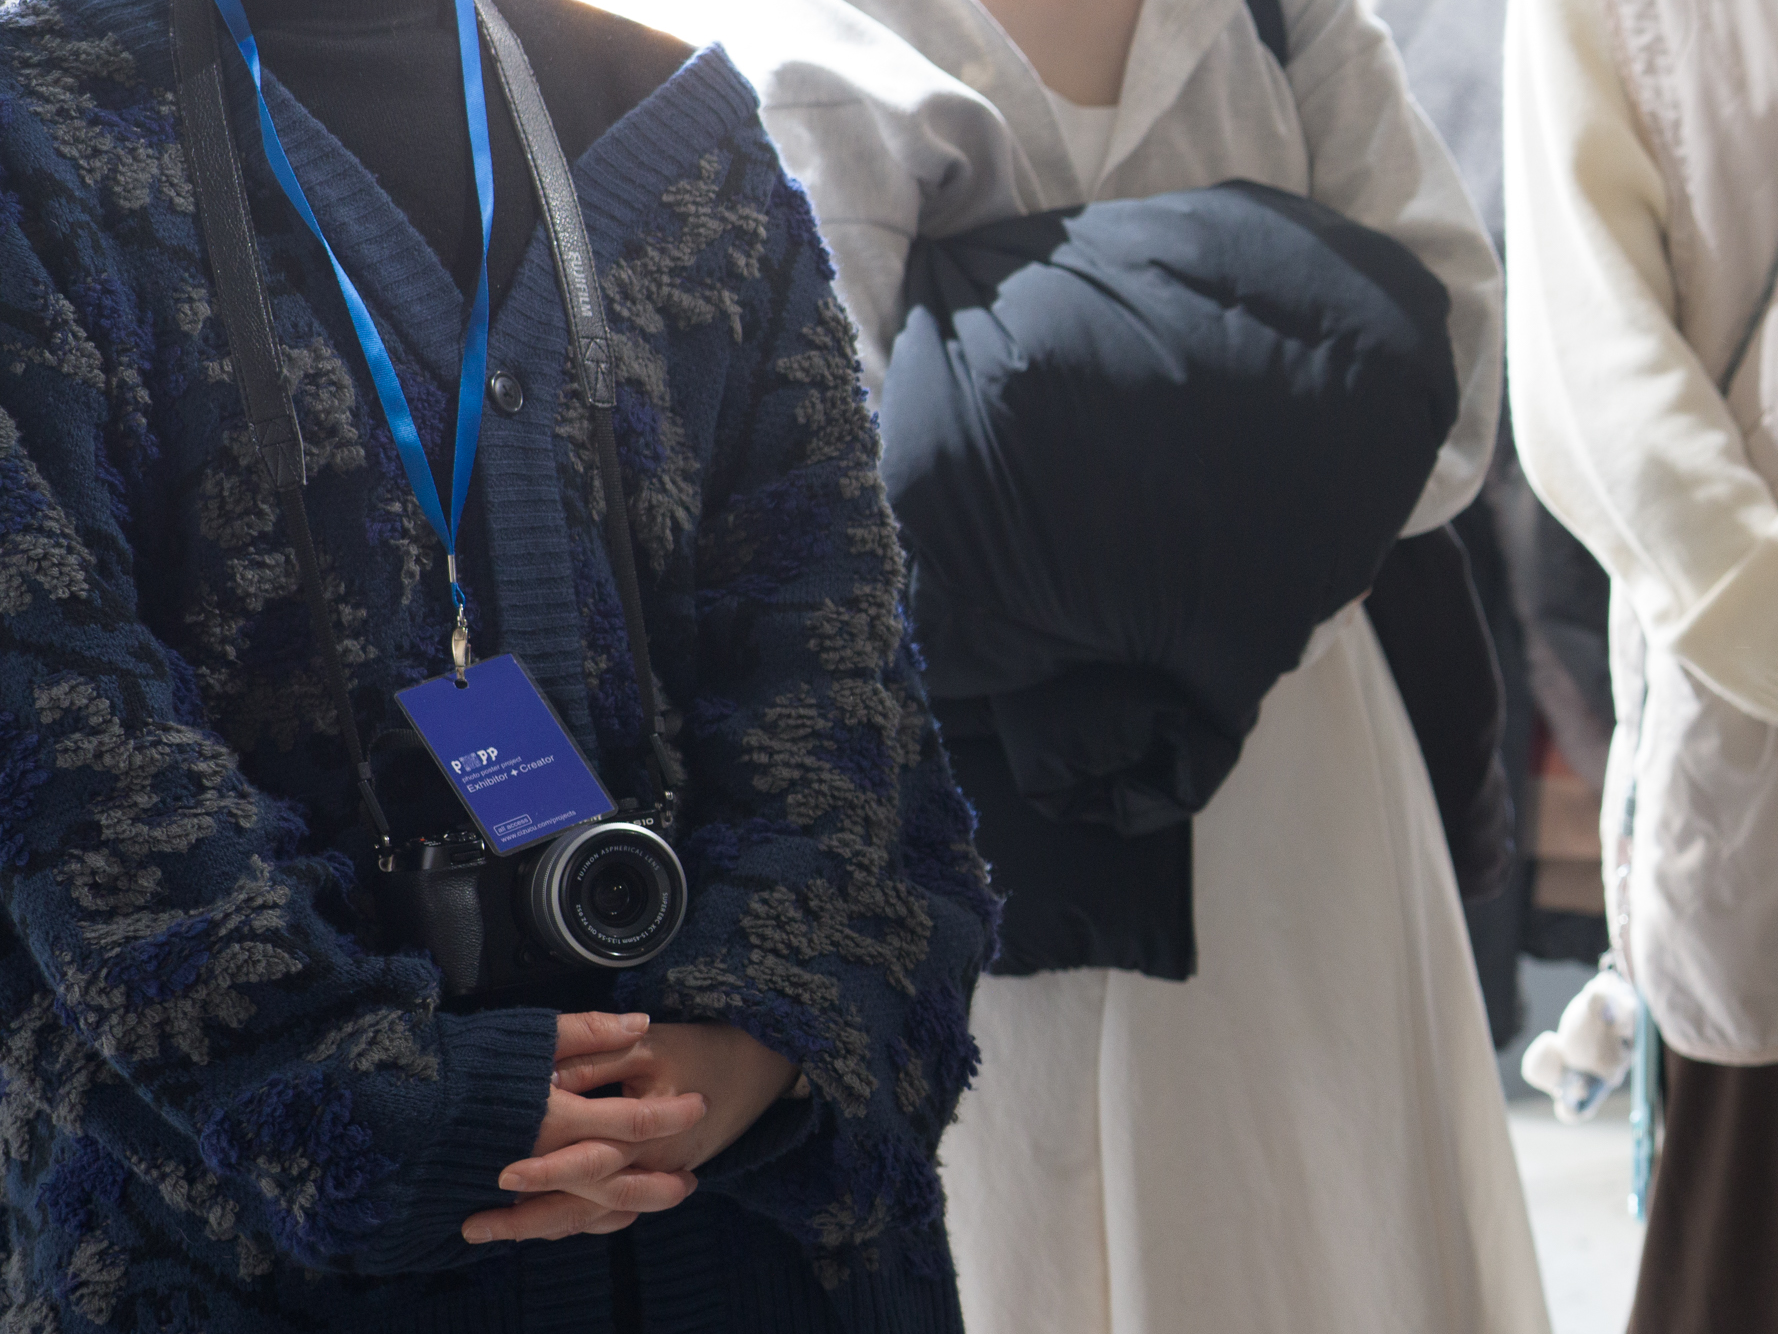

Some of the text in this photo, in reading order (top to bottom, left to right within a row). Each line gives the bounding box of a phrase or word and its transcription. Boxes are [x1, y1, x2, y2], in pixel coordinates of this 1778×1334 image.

[462, 756, 522, 783] photo poster project
[466, 755, 554, 793] Exhibitor Creator
[506, 818, 528, 829] access
[577, 845, 660, 881] FUJINON ASPHERICAL LENS
[660, 892, 669, 913] SUPER
